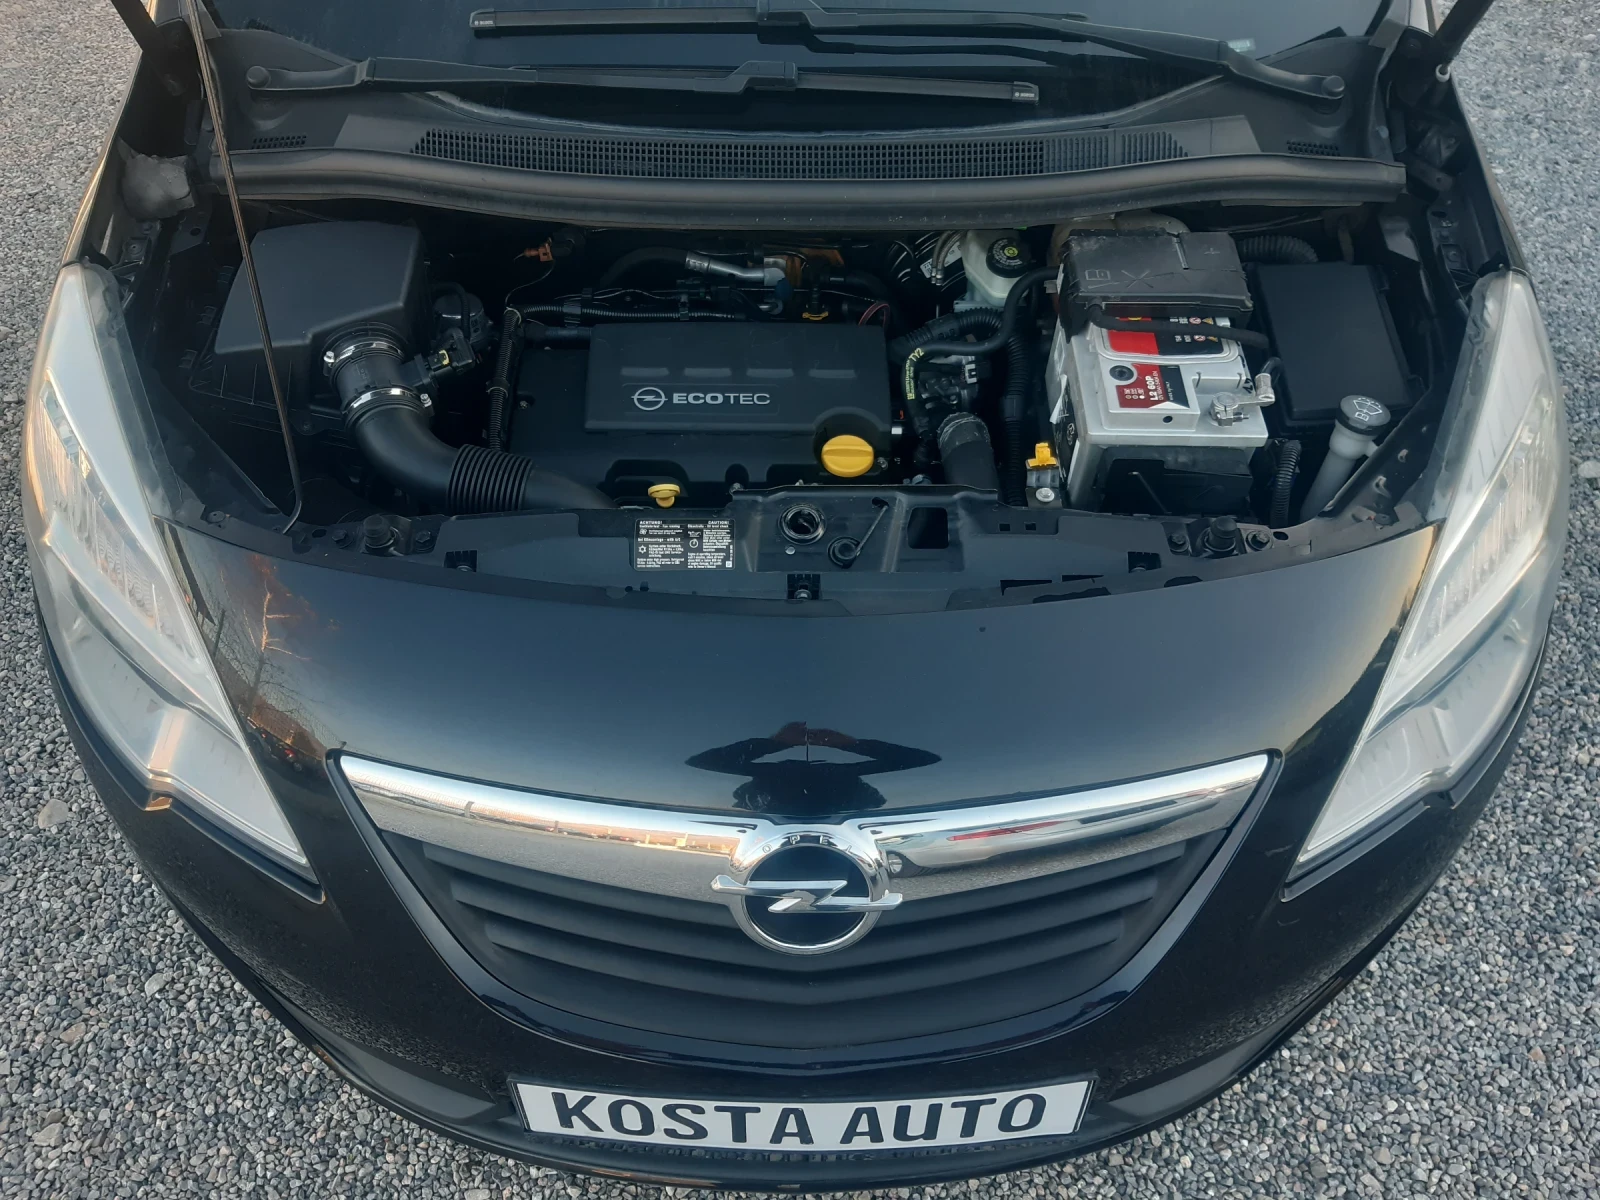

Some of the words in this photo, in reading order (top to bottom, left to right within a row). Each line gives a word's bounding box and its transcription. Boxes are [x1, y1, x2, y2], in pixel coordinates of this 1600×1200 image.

[909, 347, 924, 361] TY2
[1145, 375, 1156, 390] 60P
[673, 394, 770, 404] ECOTEC
[1148, 391, 1159, 401] L2
[761, 834, 854, 854] OPEL
[551, 1091, 812, 1145] KOSTA
[839, 1093, 1048, 1144] AUTO
